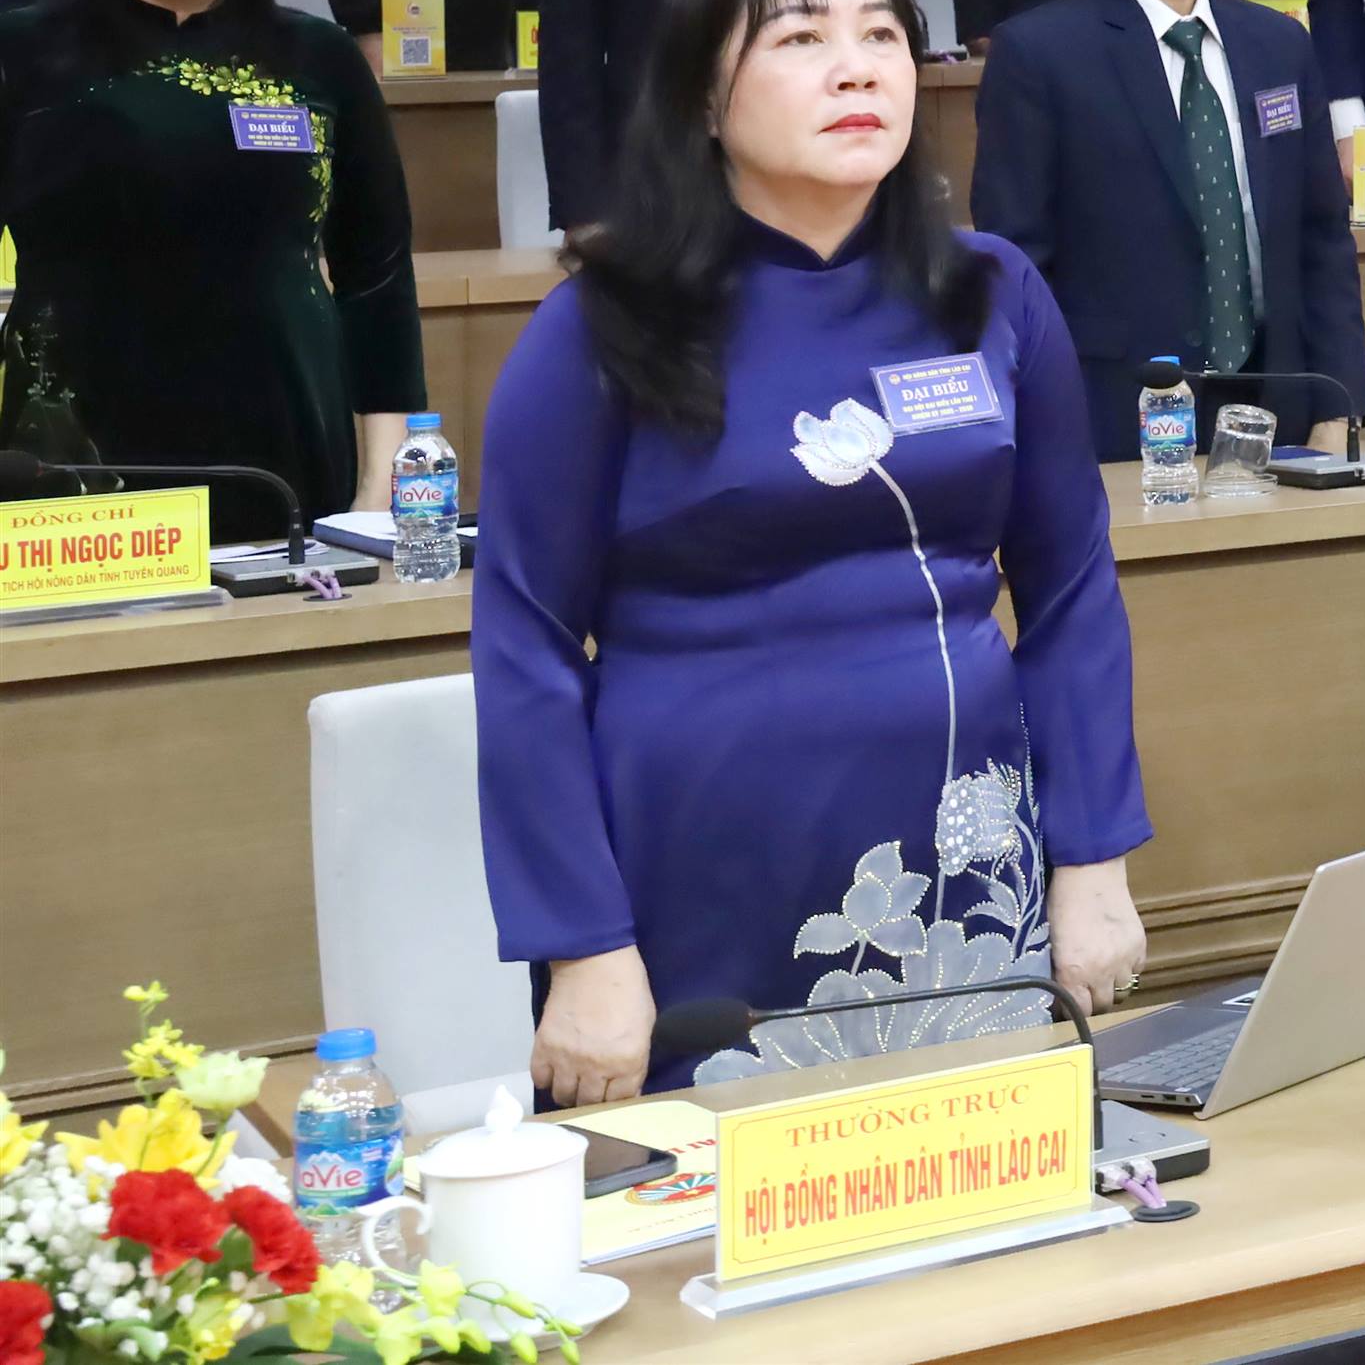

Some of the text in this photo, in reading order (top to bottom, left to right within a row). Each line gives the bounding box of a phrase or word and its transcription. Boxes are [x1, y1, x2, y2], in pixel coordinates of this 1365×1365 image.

[249, 124, 268, 134] ĐẠI
[902, 376, 968, 401] ĐẠI BIỂU
[1148, 422, 1184, 435] laVie
[400, 487, 442, 502] laVie
[13, 505, 135, 528] ĐỒNG CHÍ
[18, 539, 52, 572] THỊ
[61, 533, 123, 568] NGỌC
[131, 523, 181, 562] DIỆP
[3, 565, 189, 593] TỊCH HỘI NÔNG DÂN TỈNH TUYÊN QUANG
[786, 1084, 1029, 1147] THƯỜNG TRỰC
[745, 1177, 777, 1245] HỘI
[784, 1163, 837, 1229] ĐỒNG
[845, 1156, 897, 1217] NHÂN
[905, 1146, 942, 1204] DÂN
[949, 1133, 991, 1195] TỈNH
[998, 1129, 1030, 1186] LÀO
[1038, 1129, 1066, 1178] CAI
